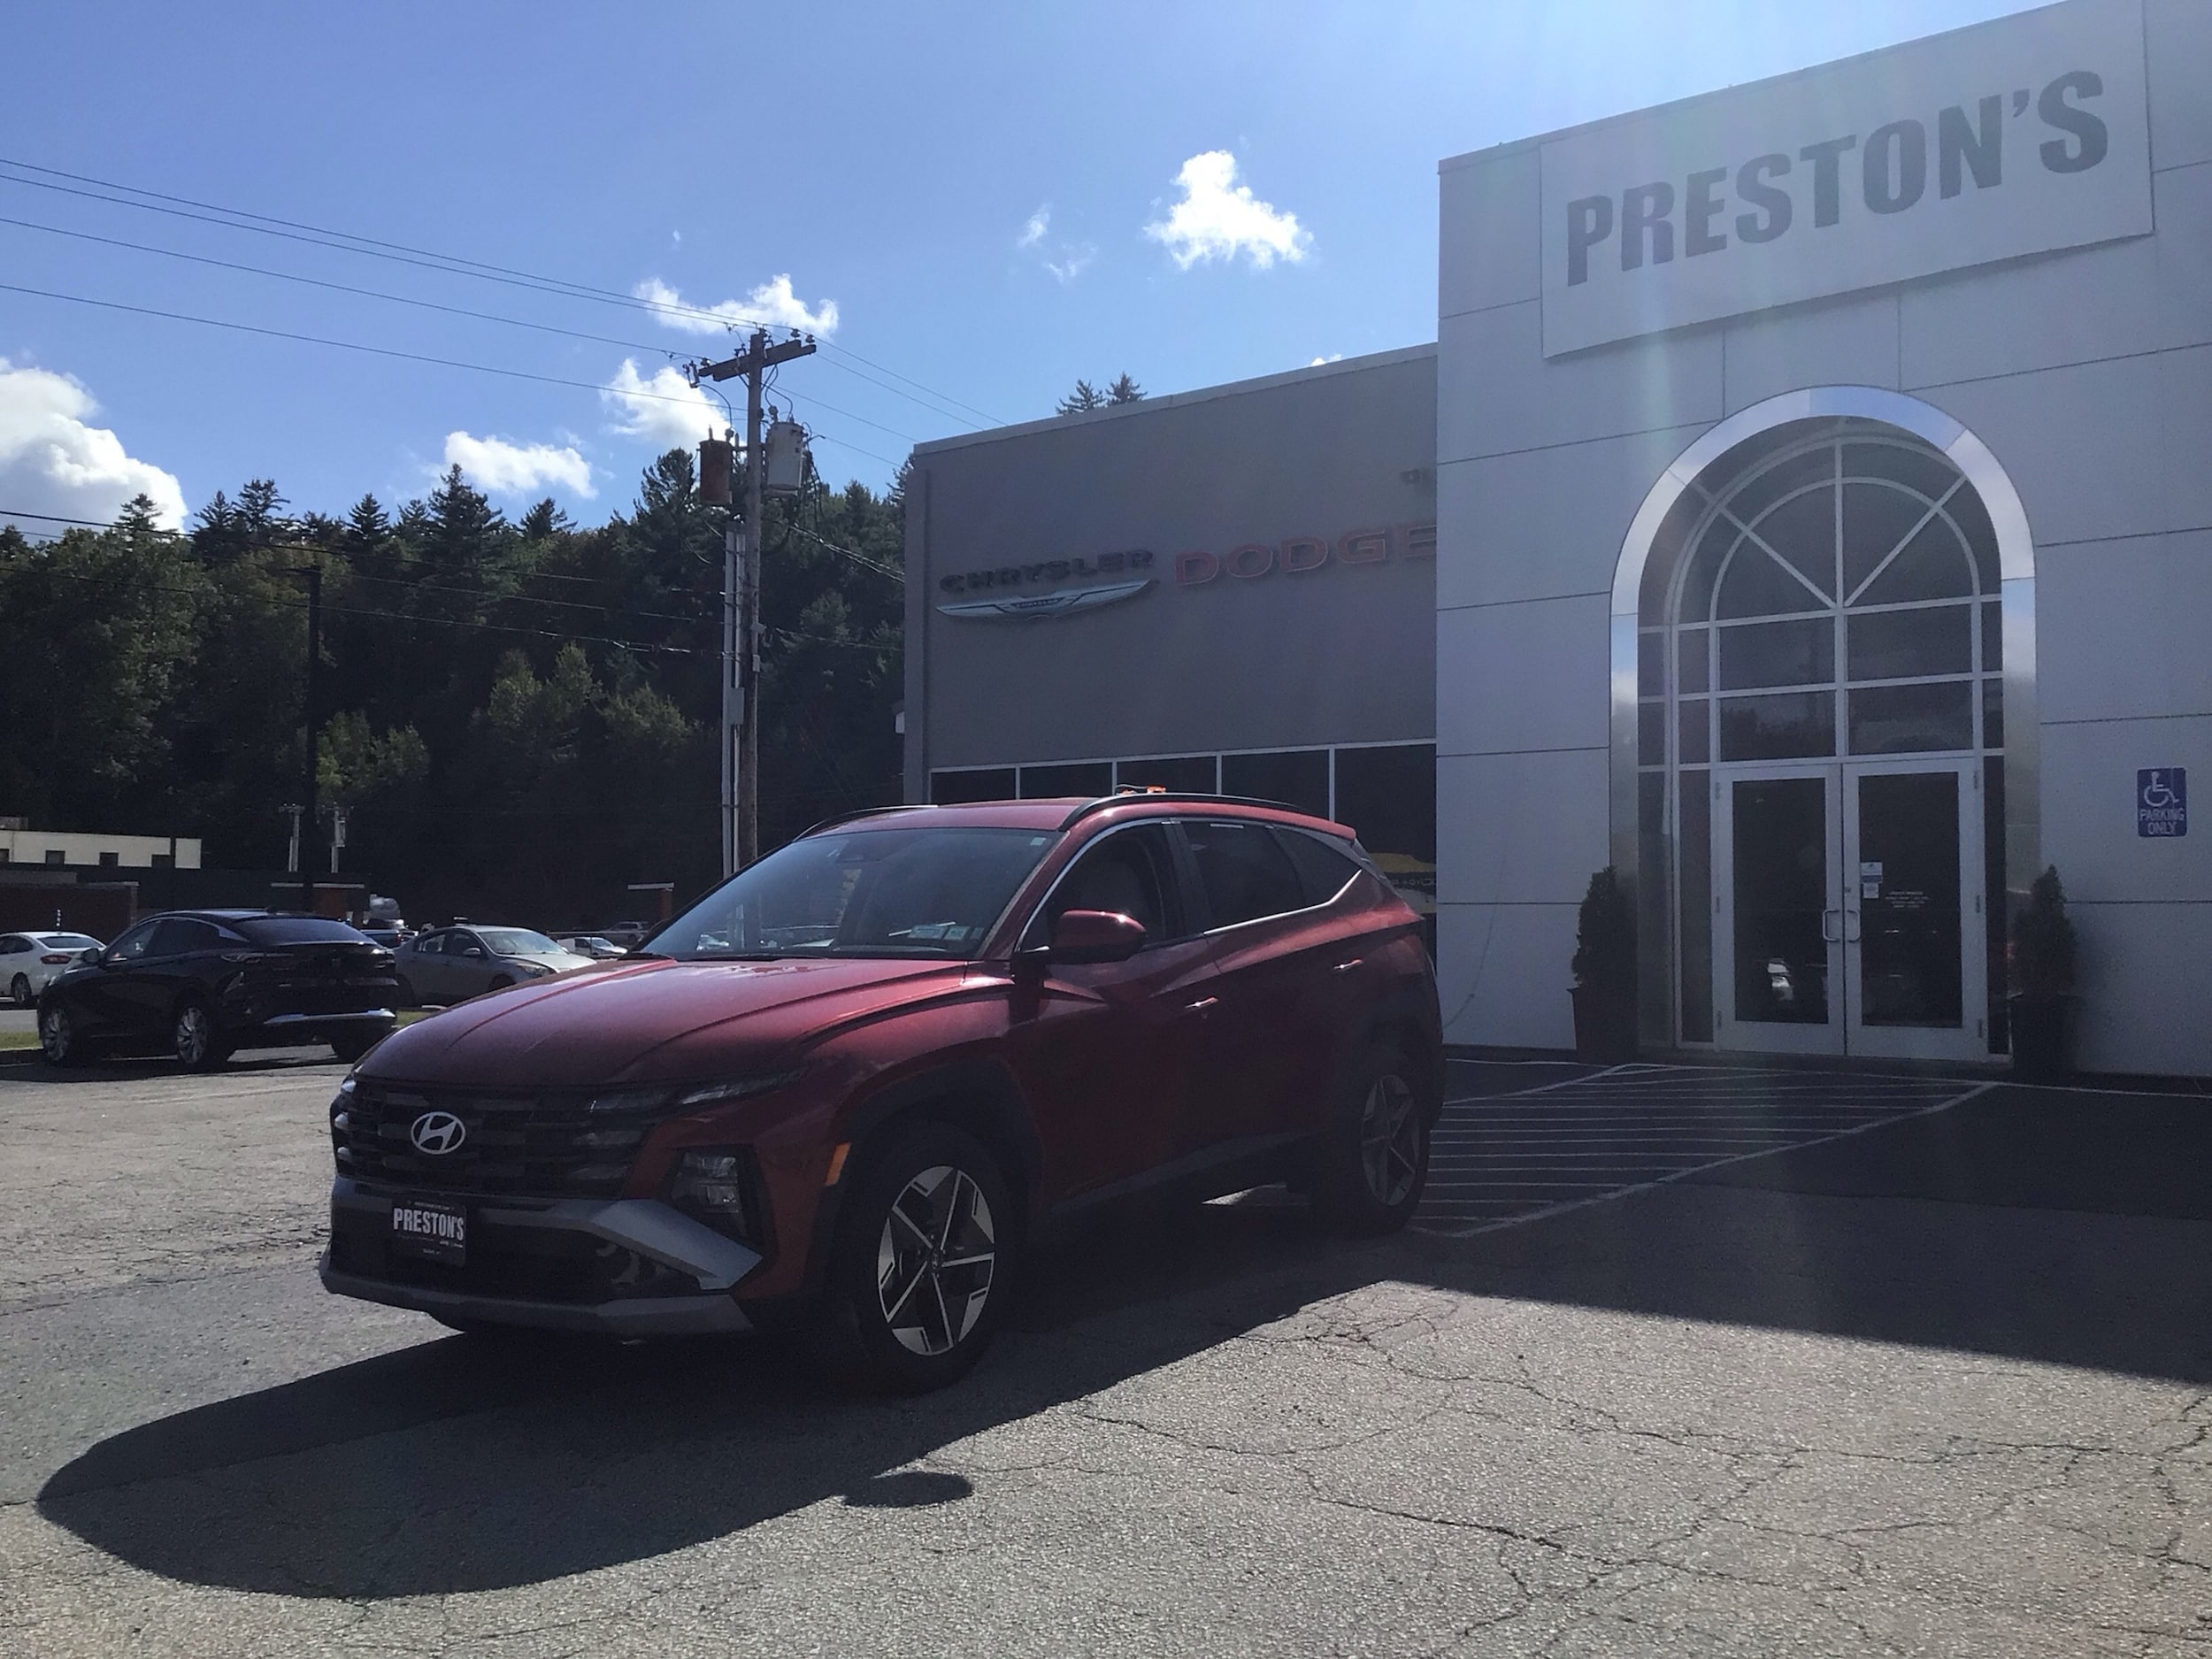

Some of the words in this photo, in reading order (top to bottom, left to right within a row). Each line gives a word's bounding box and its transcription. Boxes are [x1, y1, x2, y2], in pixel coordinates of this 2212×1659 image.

[1567, 71, 2108, 287] PRESTON'S
[939, 549, 1155, 592] CHRYSLER
[1174, 522, 1438, 587] DODGE
[2140, 808, 2185, 822] PARKING
[2147, 821, 2177, 834] ONLY
[393, 1208, 465, 1240] PRESTON'S
